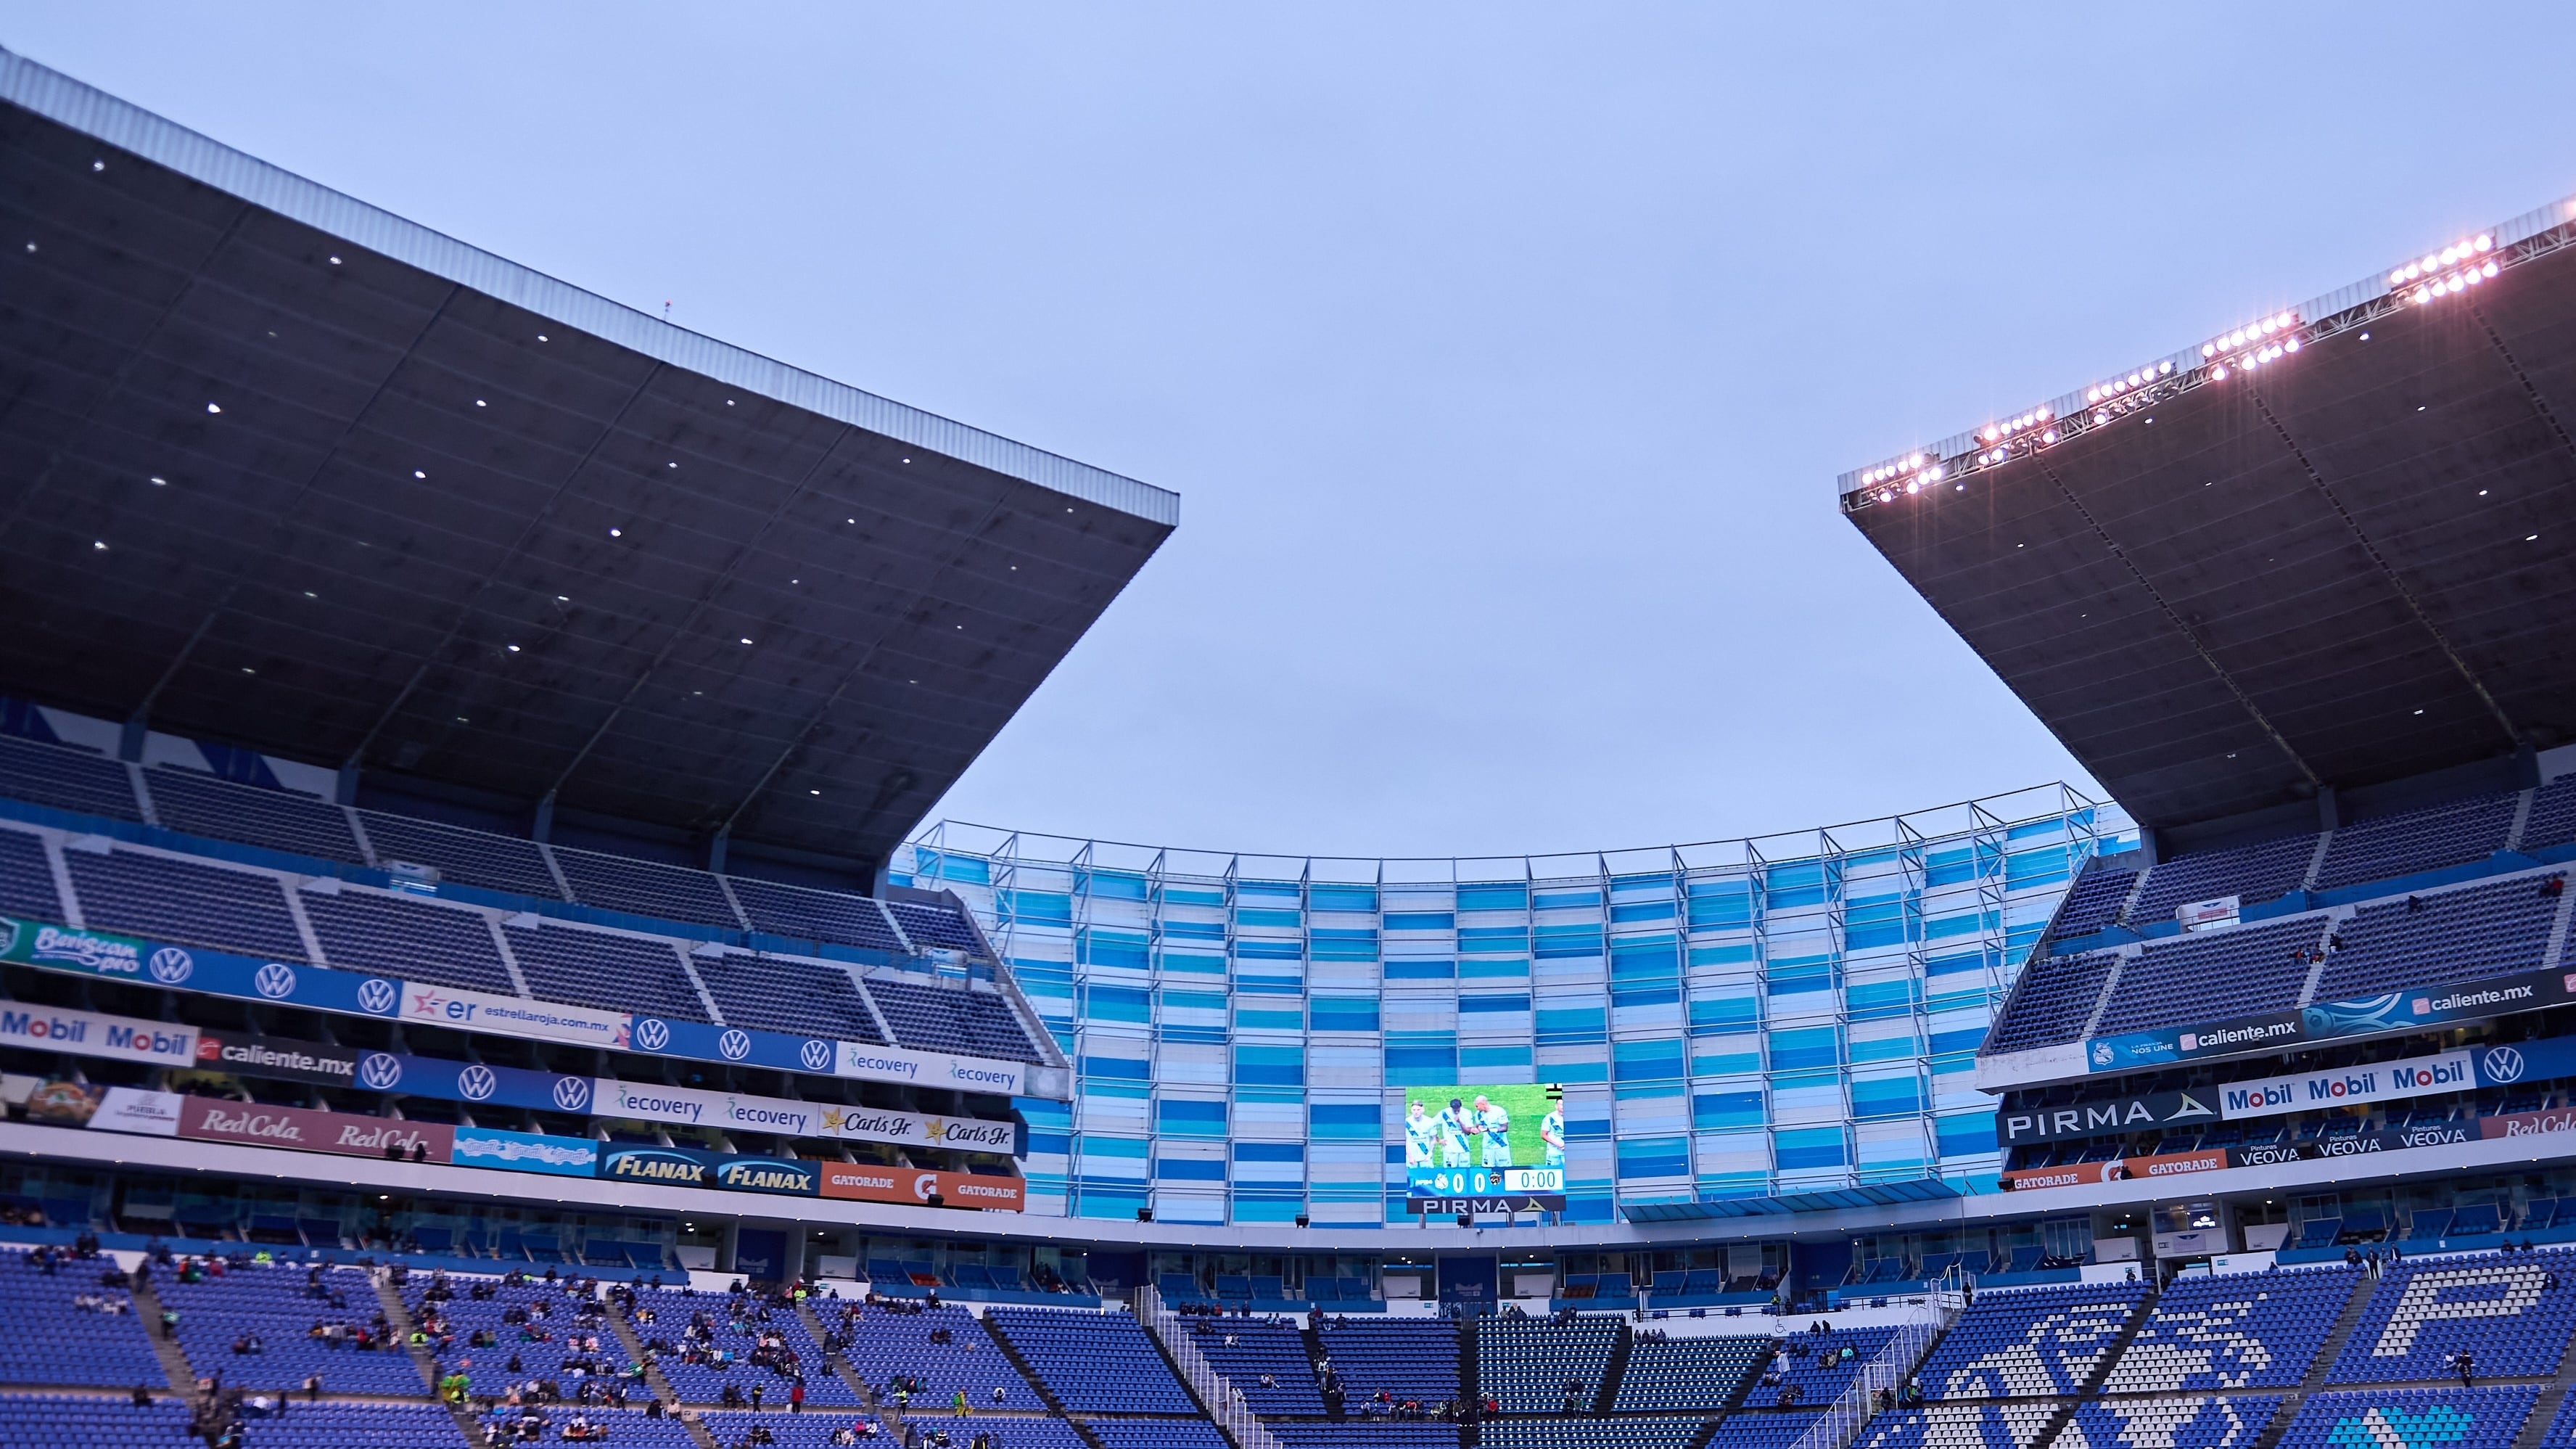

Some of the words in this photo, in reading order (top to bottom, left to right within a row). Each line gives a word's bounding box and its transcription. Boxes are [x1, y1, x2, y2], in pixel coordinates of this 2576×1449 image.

[97, 956, 140, 972] pro
[445, 998, 477, 1020] er
[2432, 985, 2533, 1011] caliente.mx
[485, 1007, 609, 1031] estrellaroja.com.mx
[1, 1011, 86, 1042] Mobil
[105, 1025, 187, 1055] Mobil
[2198, 1022, 2296, 1046] caliente.mx
[221, 1045, 355, 1076] caliente.mx
[2228, 1083, 2292, 1110] Mobil
[2308, 1072, 2376, 1100] Mobil
[2392, 1060, 2464, 1089] Mobil
[844, 1112, 888, 1132] Carl's
[889, 1117, 912, 1136] Jr.
[2007, 1101, 2155, 1139] PIRMA
[945, 1123, 988, 1142] Carl's
[988, 1128, 1010, 1145] Jr.
[2400, 1129, 2466, 1147] VEOVA
[2240, 1148, 2300, 1165] VEOVA
[2318, 1139, 2381, 1157] VEOVA
[615, 1155, 705, 1182] FLANAX
[728, 1165, 811, 1191] FLANAX
[2149, 1159, 2217, 1175] GATORADE
[831, 1175, 894, 1189] GATORADE
[914, 1174, 937, 1199] G
[1452, 1173, 1464, 1193] 0
[1474, 1173, 1485, 1193] 0
[1521, 1171, 1555, 1188] 0:00
[2015, 1173, 2078, 1189] GATORADE
[958, 1184, 1017, 1199] GATORADE
[1423, 1199, 1511, 1213] PIRMA
